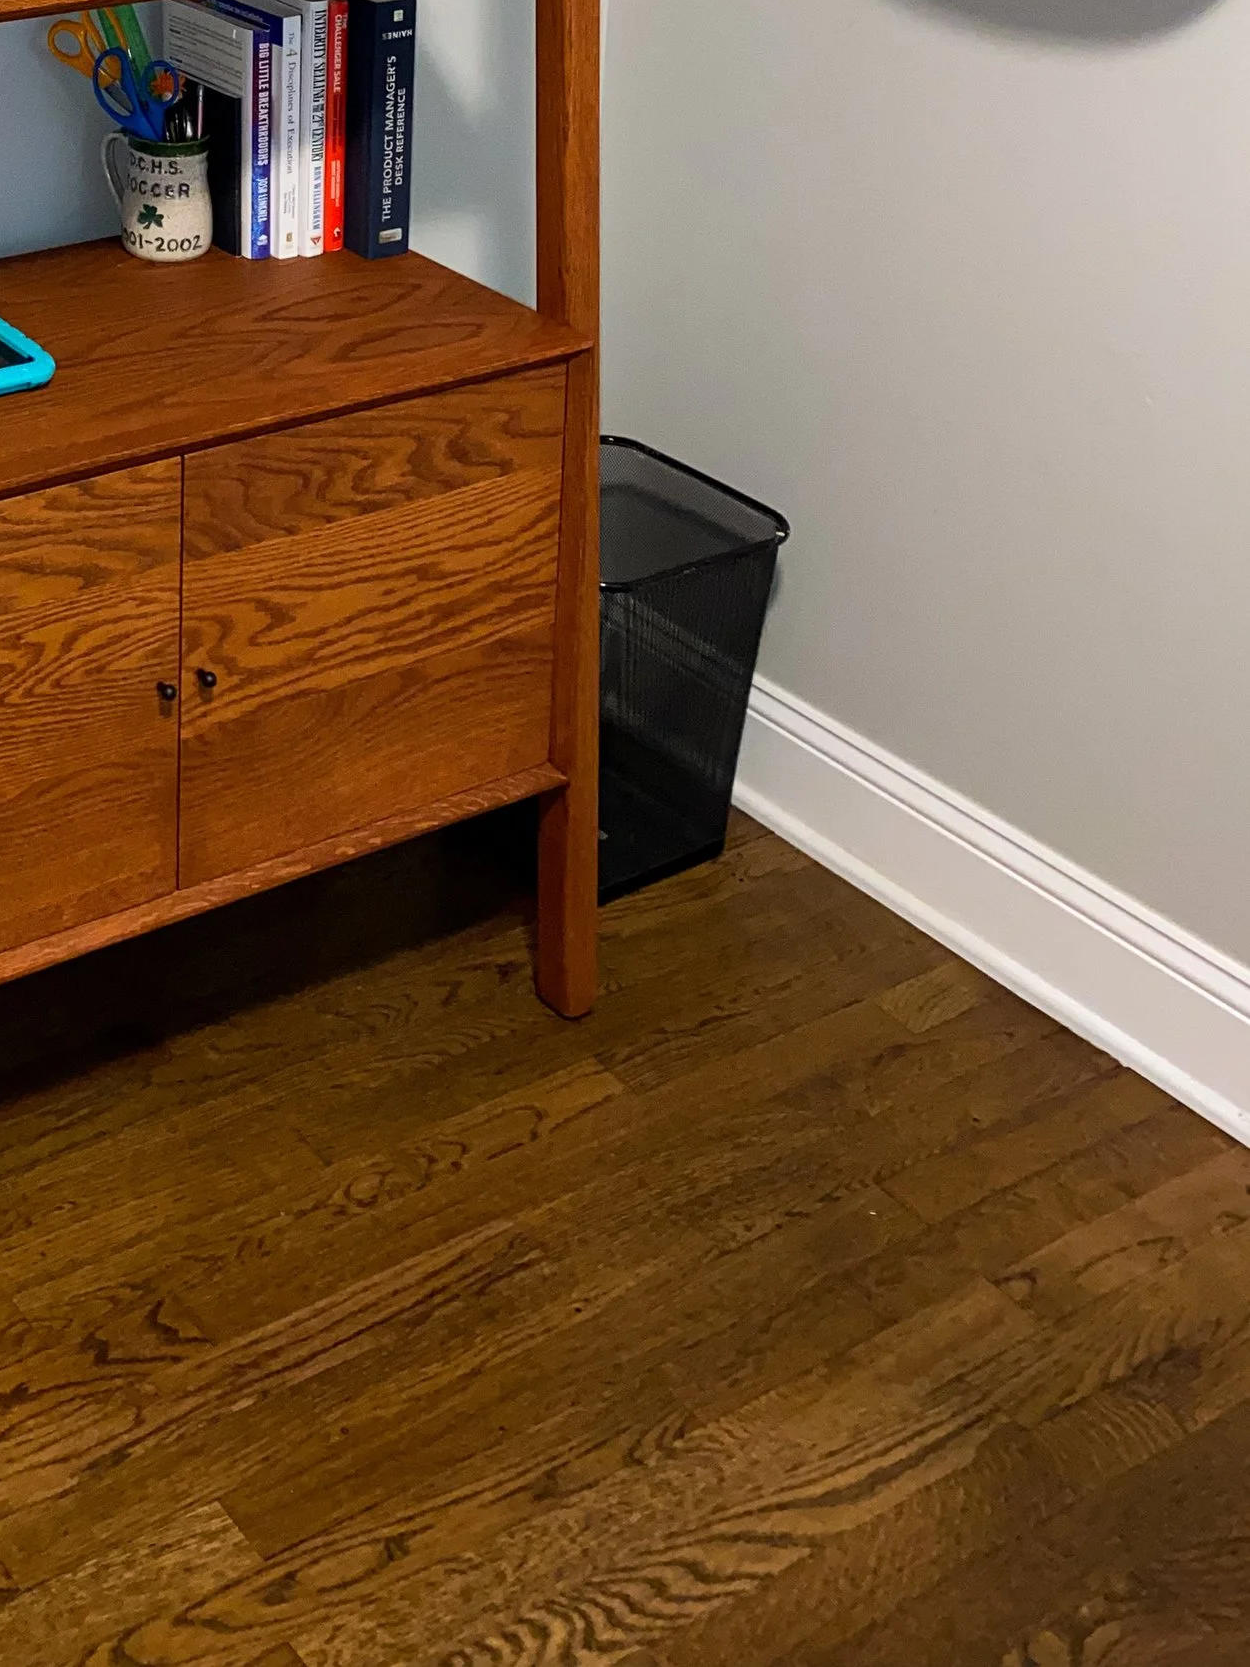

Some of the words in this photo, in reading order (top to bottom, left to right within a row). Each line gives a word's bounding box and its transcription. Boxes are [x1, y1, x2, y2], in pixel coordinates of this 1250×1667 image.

[258, 43, 270, 59] BIG
[313, 9, 327, 59] INTEGRITY
[334, 14, 342, 70] CHALLENGER
[381, 28, 413, 41] HAINES
[285, 48, 298, 57] 4
[258, 61, 270, 91] LITTLE
[286, 62, 297, 112] Disciplines
[312, 62, 326, 103] SELLING
[333, 71, 341, 93] SALE
[384, 55, 397, 131] MANAGER'S
[257, 91, 270, 166] BREAKTHROUGHS
[287, 115, 295, 125] of
[395, 87, 406, 152] REFERENCE
[286, 128, 295, 174] Execution
[311, 127, 325, 162] CENTURY
[314, 166, 322, 181] RON
[382, 134, 394, 193] PRODUCT
[394, 155, 404, 185] DESK
[257, 177, 268, 194] JOSH
[313, 182, 321, 230] WILLINGHAM
[381, 197, 392, 222] THE
